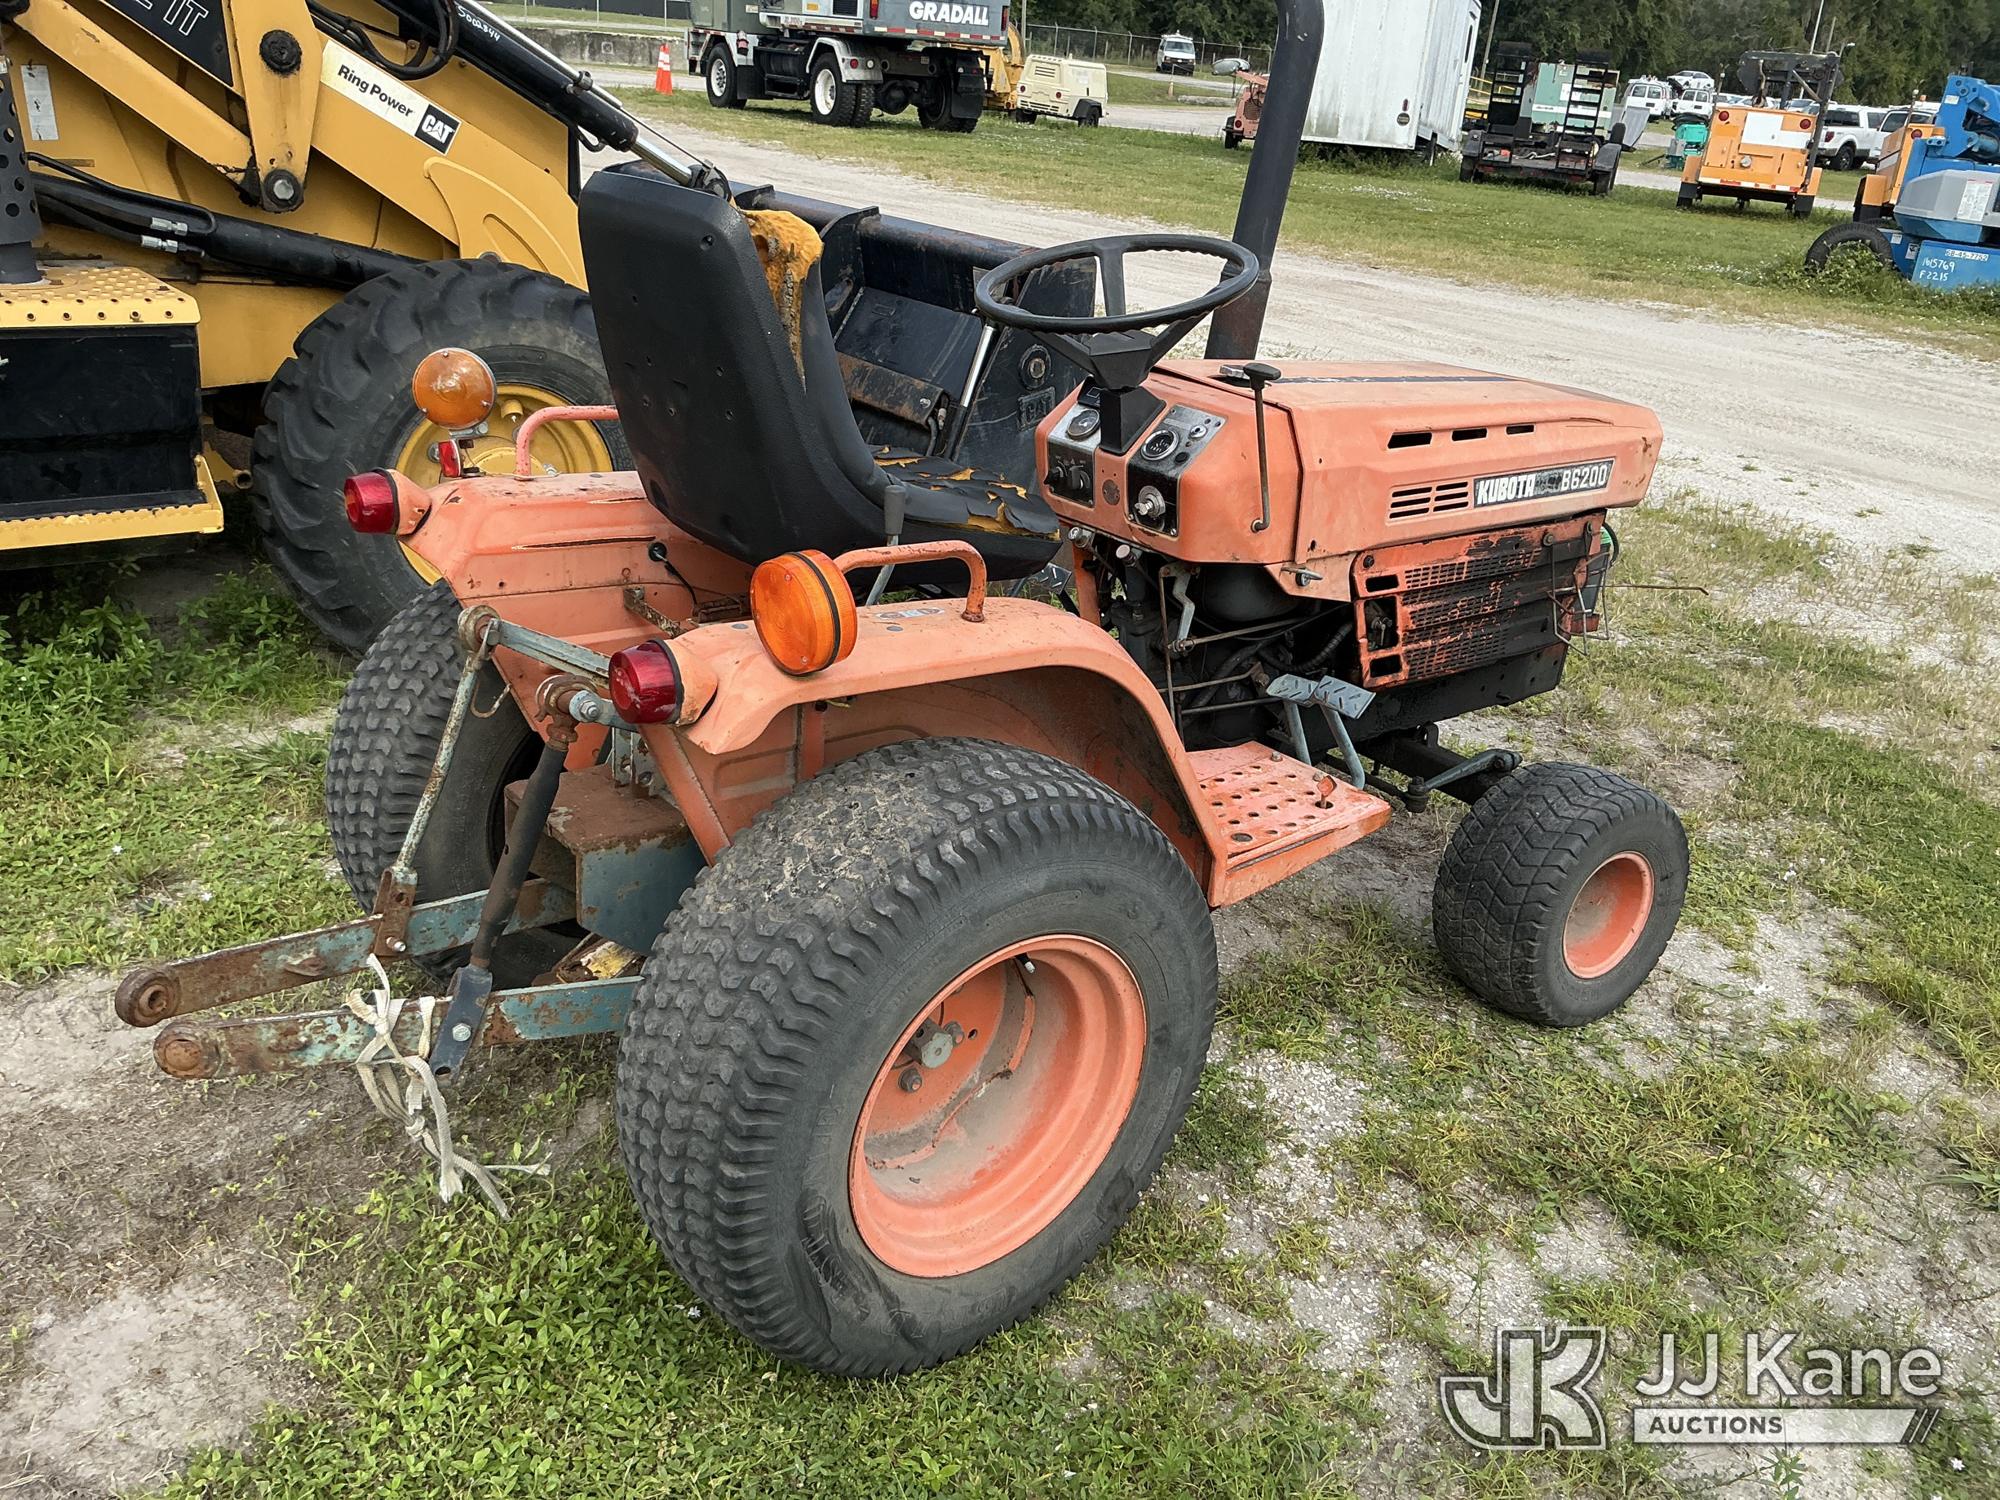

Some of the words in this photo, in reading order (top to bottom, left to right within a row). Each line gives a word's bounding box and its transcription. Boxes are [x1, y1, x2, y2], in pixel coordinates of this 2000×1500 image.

[909, 1, 989, 26] GRADALL
[337, 64, 370, 93] Ring
[369, 83, 413, 117] Power
[421, 114, 456, 144] CAT
[1477, 473, 1537, 505] KUBOTA
[1560, 464, 1609, 492] B6200
